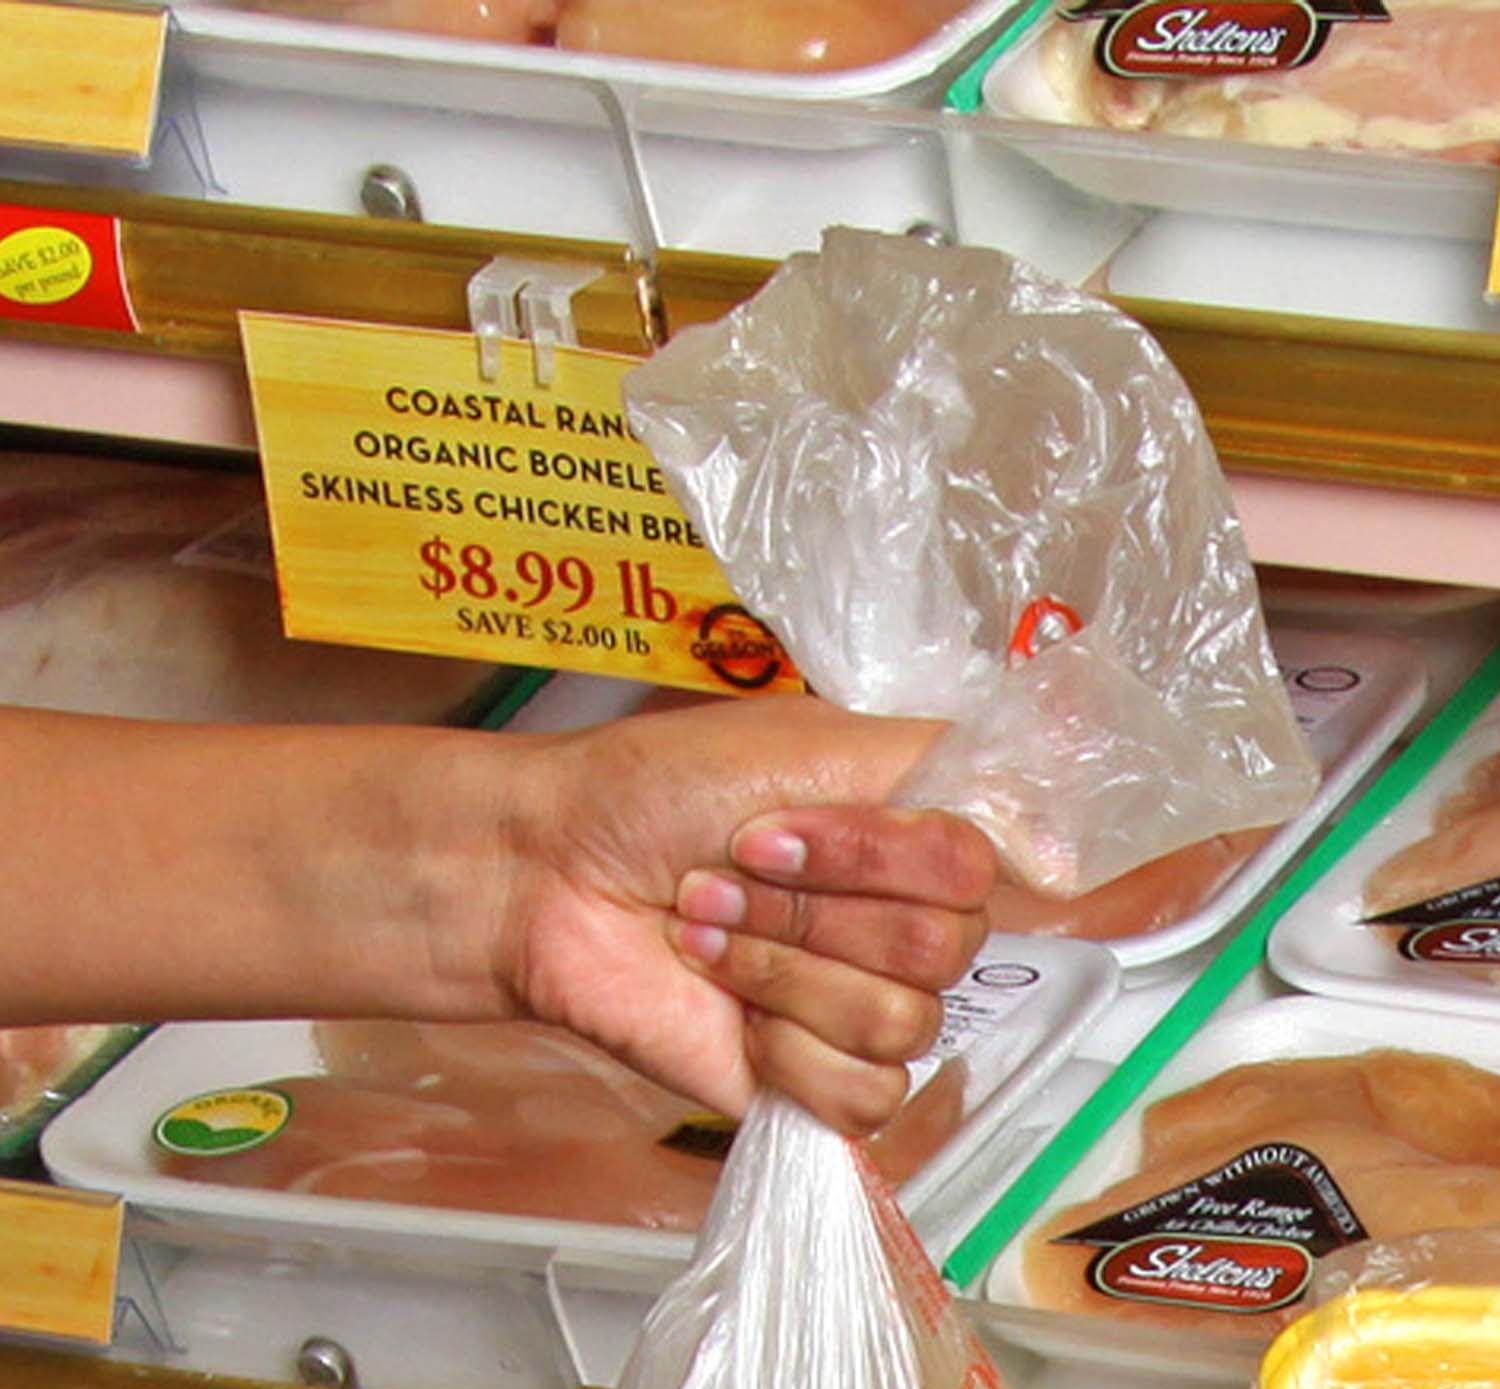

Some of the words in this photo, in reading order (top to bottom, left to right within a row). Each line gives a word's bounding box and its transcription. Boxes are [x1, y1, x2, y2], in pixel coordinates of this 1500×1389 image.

[1136, 8, 1288, 54] Shelton's
[385, 386, 547, 431] COASTAL
[353, 430, 519, 474] ORGANIC
[530, 448, 667, 496] BONELE
[301, 471, 465, 516] SKINLESS
[474, 491, 632, 537] CHICKEN
[643, 512, 705, 549] BRE
[419, 534, 595, 614] $8.99
[617, 559, 680, 623] lb
[457, 608, 534, 640] SAVE
[543, 617, 617, 651] $2.00
[625, 629, 652, 657] lb
[1204, 1147, 1308, 1189] WITHOUT
[1186, 1196, 1238, 1219] Free
[1240, 1198, 1314, 1227] Range
[1129, 1243, 1285, 1290] Shelton's
